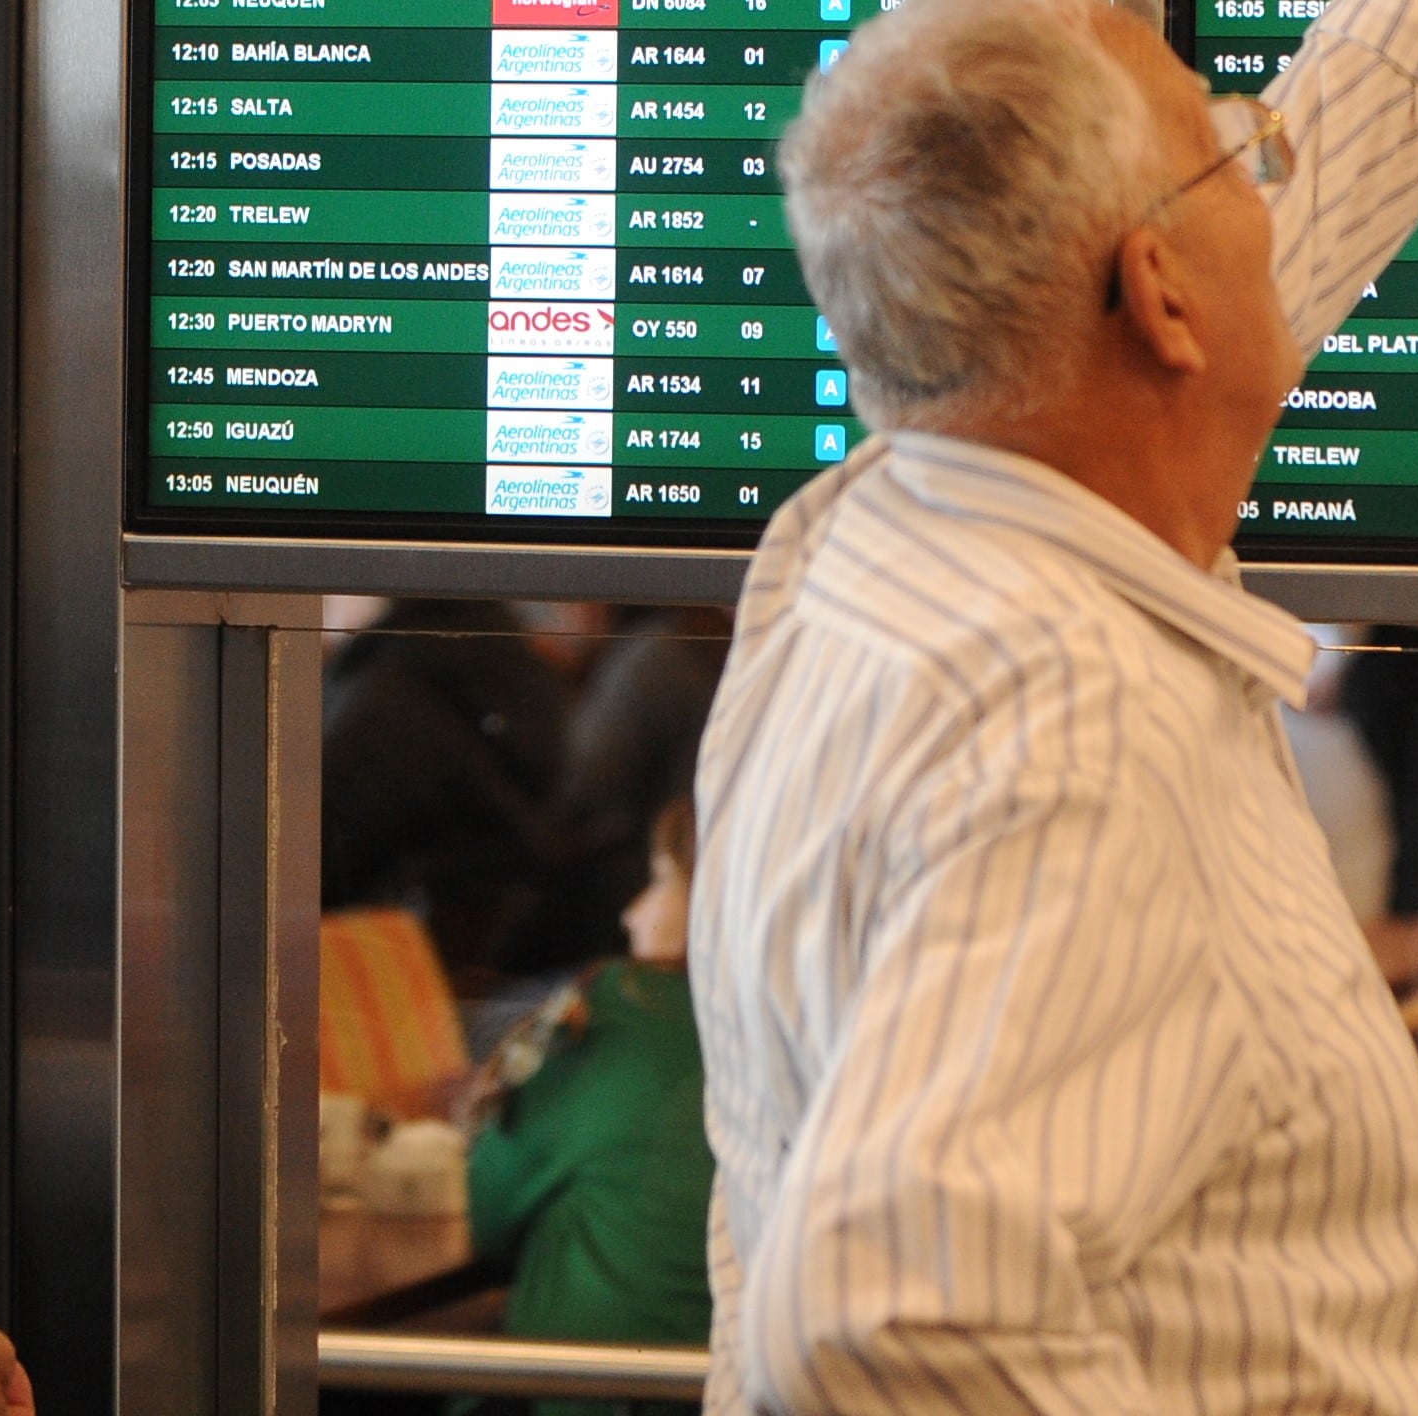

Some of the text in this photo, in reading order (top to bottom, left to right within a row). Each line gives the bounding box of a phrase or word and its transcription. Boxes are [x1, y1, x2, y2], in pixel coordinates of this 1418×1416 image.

[169, 309, 762, 339] 12:30 PUERTO MADRYN andes OY 550 09
[167, 474, 758, 503] 13:05 NEUQUÉN AR 1650 01
[1274, 500, 1356, 520] PARANÁ
